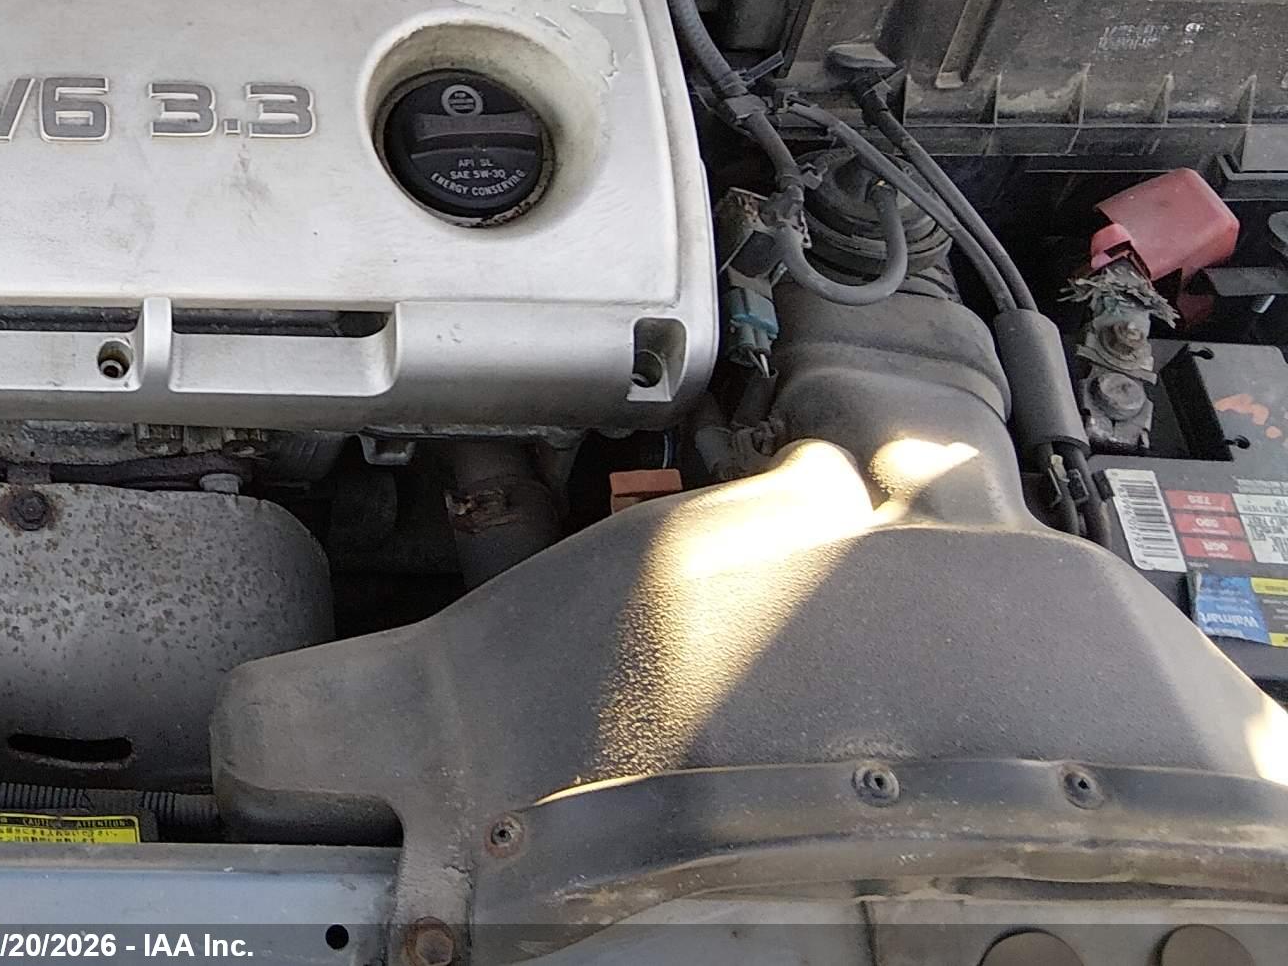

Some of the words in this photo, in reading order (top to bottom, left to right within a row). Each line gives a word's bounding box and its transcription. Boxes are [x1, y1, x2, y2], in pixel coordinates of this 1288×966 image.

[148, 82, 315, 138] 3.3
[431, 173, 469, 194] ENERGY
[472, 170, 525, 196] CONSERVING
[450, 171, 470, 179] SAE
[1199, 613, 1259, 628] Walmart
